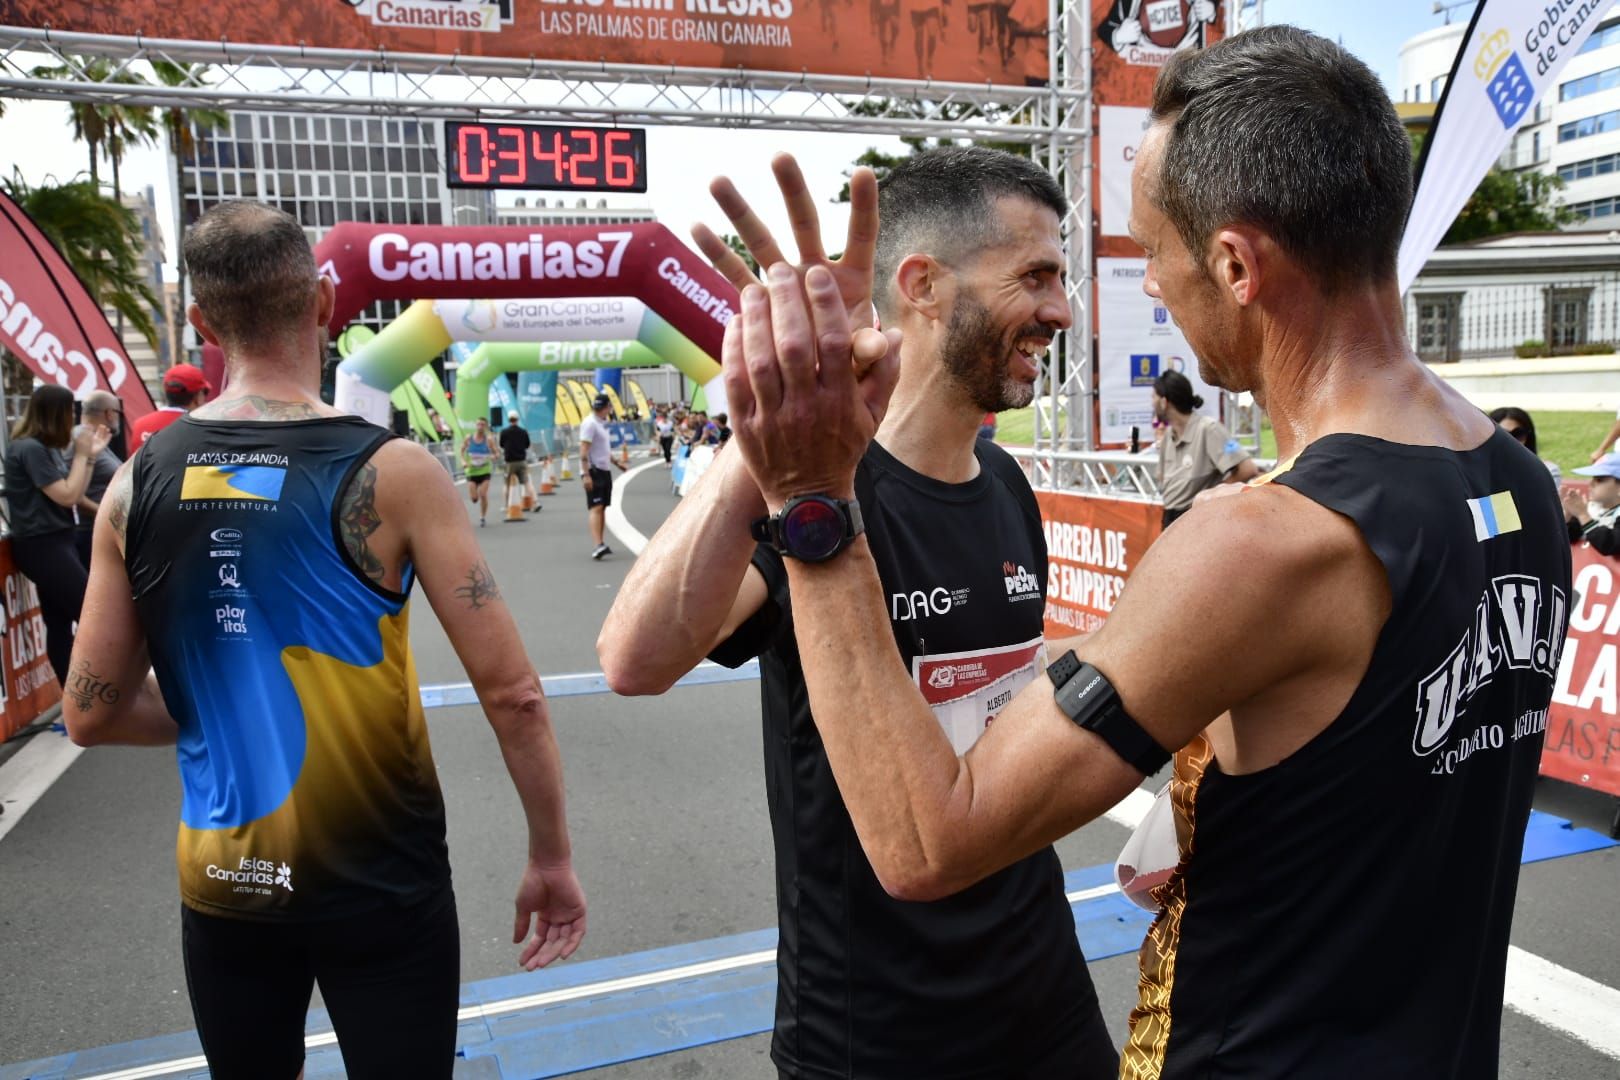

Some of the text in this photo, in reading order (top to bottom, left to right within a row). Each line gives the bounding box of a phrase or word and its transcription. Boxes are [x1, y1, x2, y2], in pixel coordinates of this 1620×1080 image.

[376, 2, 496, 28] Canarias7
[540, 11, 792, 47] LAS PALMAS DE GRAN CANARIA
[1537, 45, 1558, 76] de
[458, 126, 634, 186] 0:34:26
[368, 231, 634, 281] Canarias7
[539, 340, 631, 365] Binter
[186, 453, 229, 464] PLAYAS
[230, 454, 246, 464] DE
[178, 502, 278, 513] FUERTEVENTURA
[1105, 529, 1127, 571] DE
[216, 604, 246, 624] play
[893, 587, 951, 620] DAG
[223, 620, 247, 634] itas
[987, 689, 1013, 713] ALBERTO
[206, 864, 275, 885] Canarias
[239, 856, 275, 872] Islas
